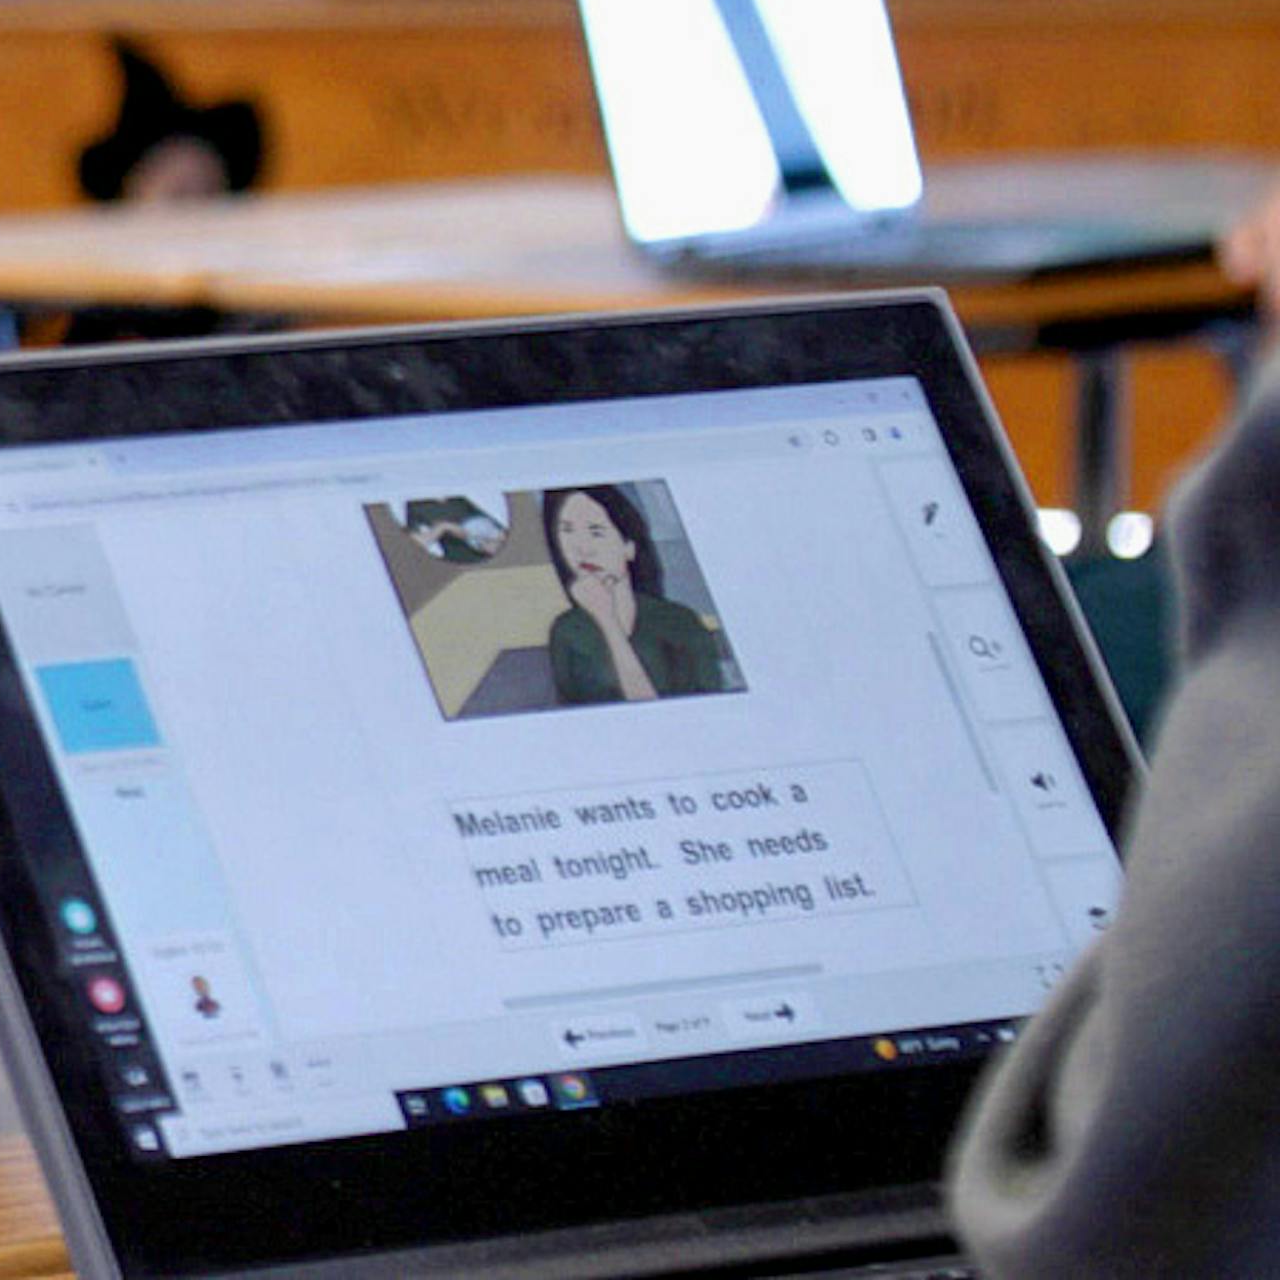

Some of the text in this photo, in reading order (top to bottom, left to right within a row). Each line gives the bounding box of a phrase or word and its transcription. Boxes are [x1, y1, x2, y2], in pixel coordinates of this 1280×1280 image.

[453, 782, 809, 838] Melanie wants to cook a
[474, 828, 829, 888] meal tonight. She needs
[493, 872, 876, 938] to prepare a shopping list.
